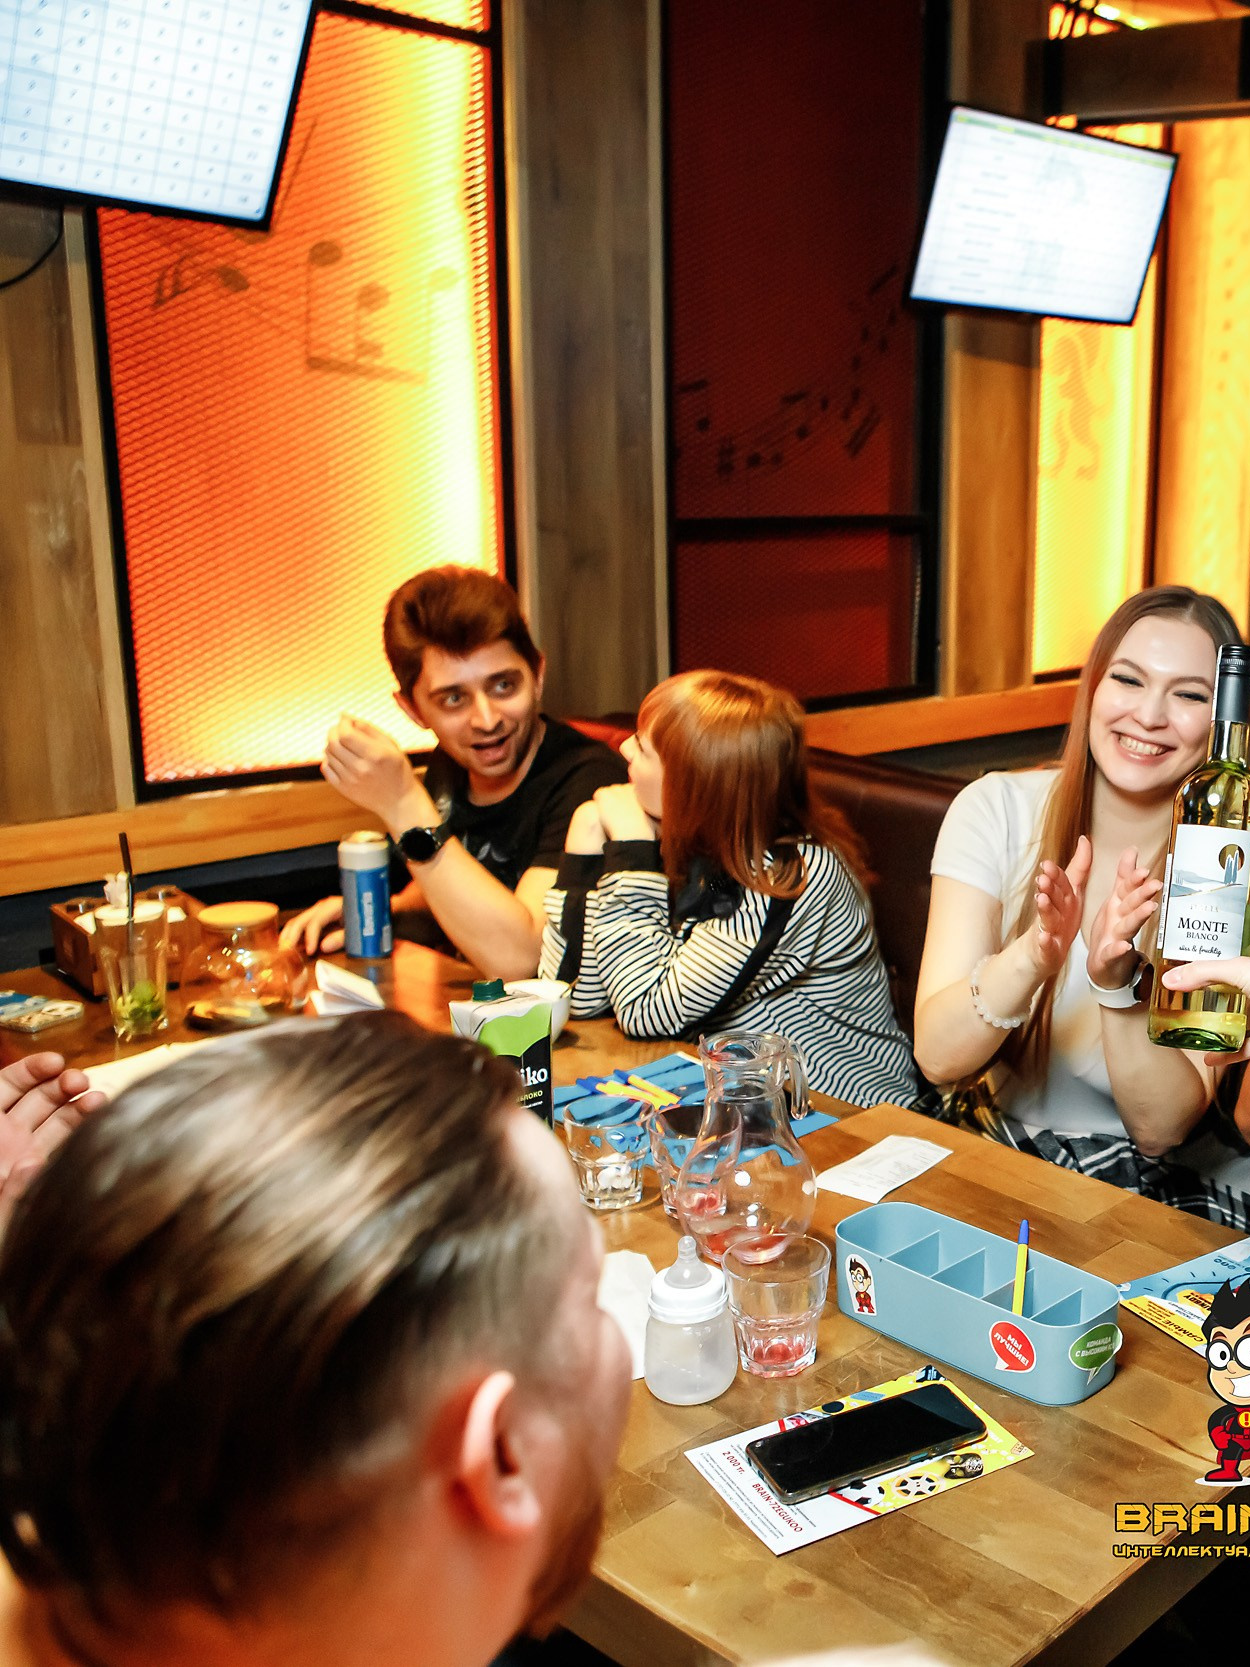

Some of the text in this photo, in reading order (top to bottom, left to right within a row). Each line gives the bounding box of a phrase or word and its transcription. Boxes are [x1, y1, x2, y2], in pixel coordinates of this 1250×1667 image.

[1178, 917, 1228, 933] MONTE
[1186, 931, 1219, 941] BIANCO
[1198, 945, 1222, 958] fruchtig
[520, 1066, 548, 1087] iko
[1162, 1319, 1204, 1342] САМЫЕ
[993, 1332, 1029, 1367] ЛУЧШИЕ!
[1007, 1334, 1022, 1350] МЫ
[726, 1455, 741, 1467] 000
